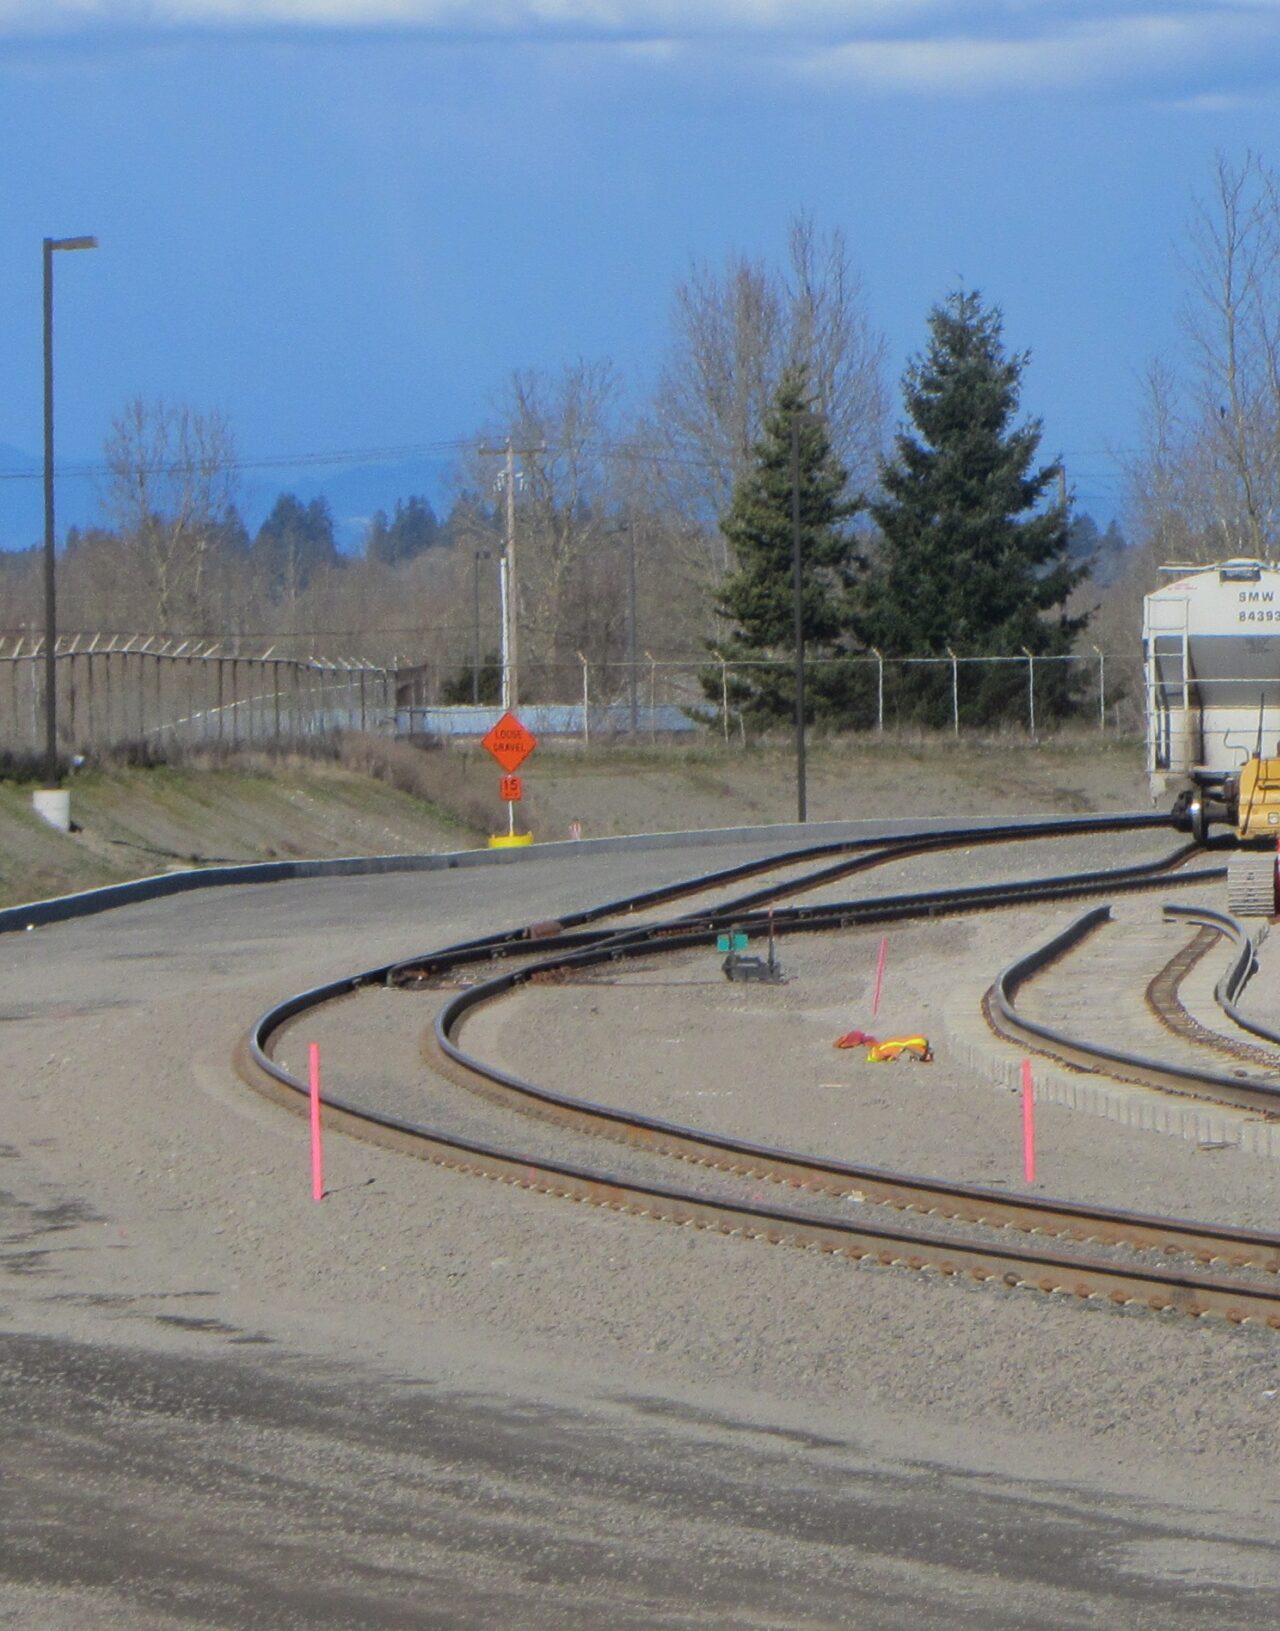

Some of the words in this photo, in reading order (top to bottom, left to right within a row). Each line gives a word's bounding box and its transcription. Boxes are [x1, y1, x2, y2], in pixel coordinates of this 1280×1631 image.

[1239, 591, 1273, 602] SMW
[495, 729, 521, 739] LOOSE
[493, 743, 526, 752] GRAVEL
[504, 779, 518, 791] 15
